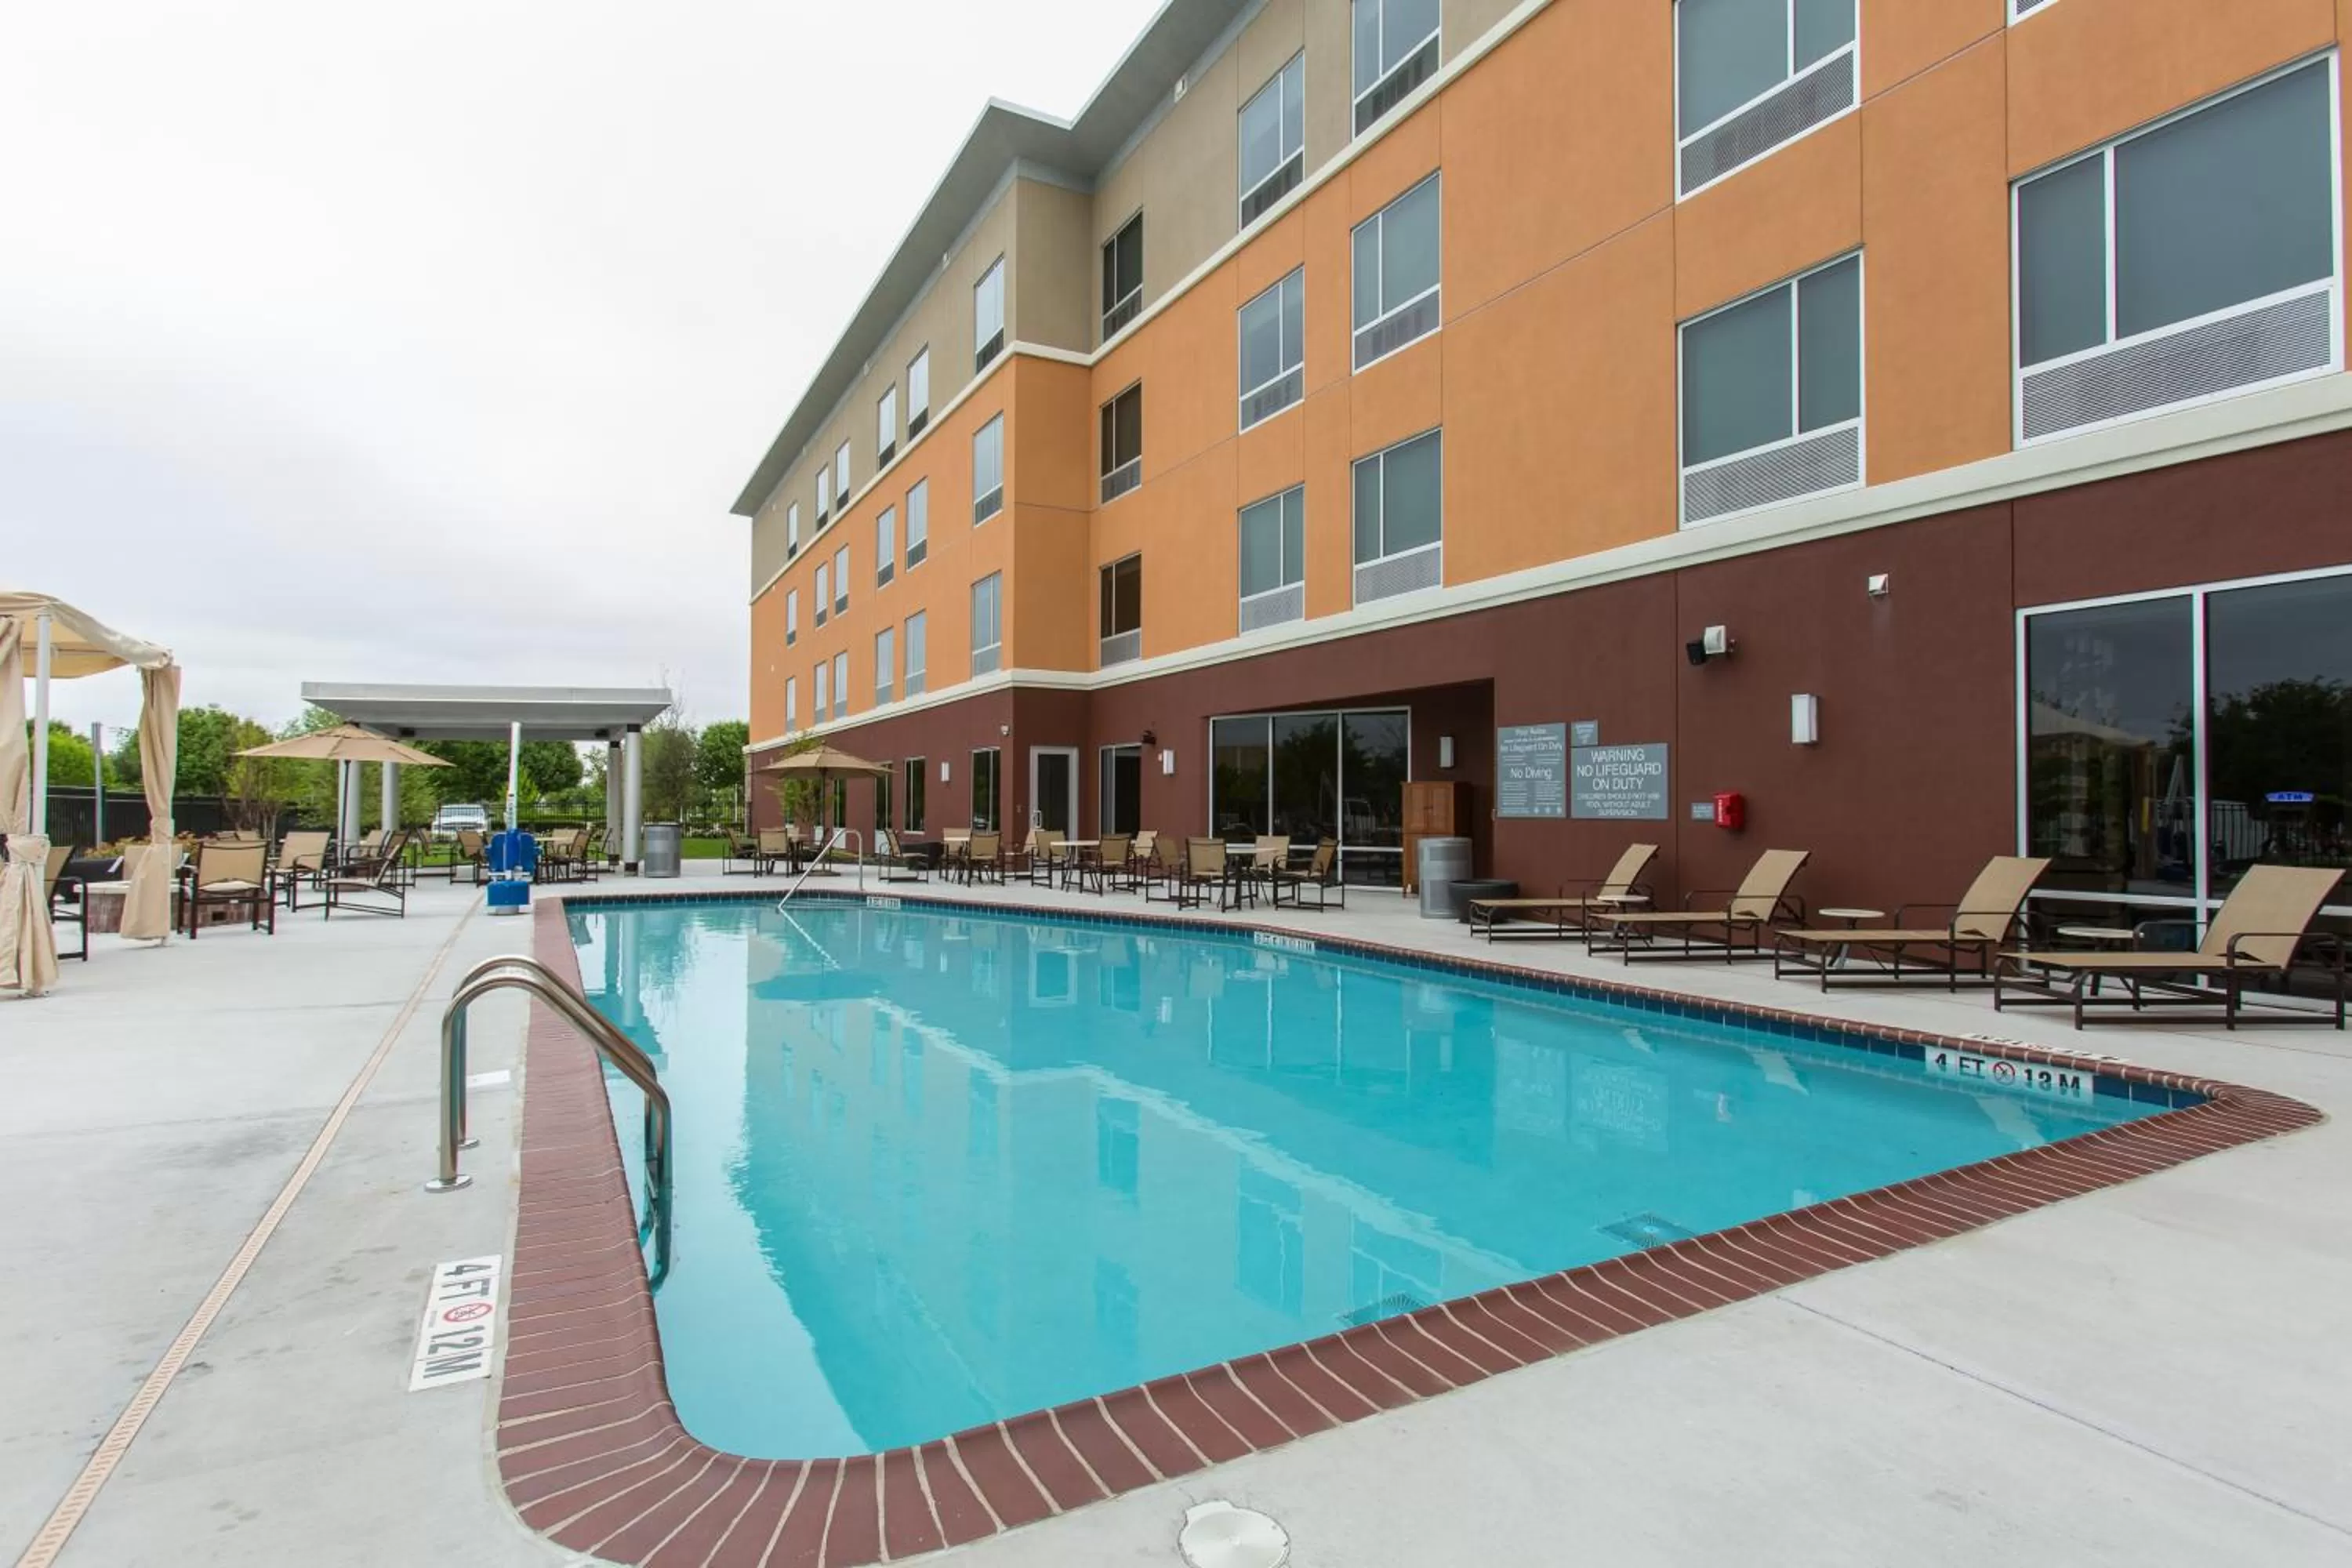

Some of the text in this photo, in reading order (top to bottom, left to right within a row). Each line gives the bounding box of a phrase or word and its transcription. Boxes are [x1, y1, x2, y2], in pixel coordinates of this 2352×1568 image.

[1591, 748, 1645, 763] WARNING
[1510, 766, 1552, 781] No Diving
[1577, 762, 1661, 778] NO LIFEGUARD
[1592, 777, 1644, 791] ON DUTY
[444, 1265, 492, 1276] 4
[438, 1278, 490, 1301] FT
